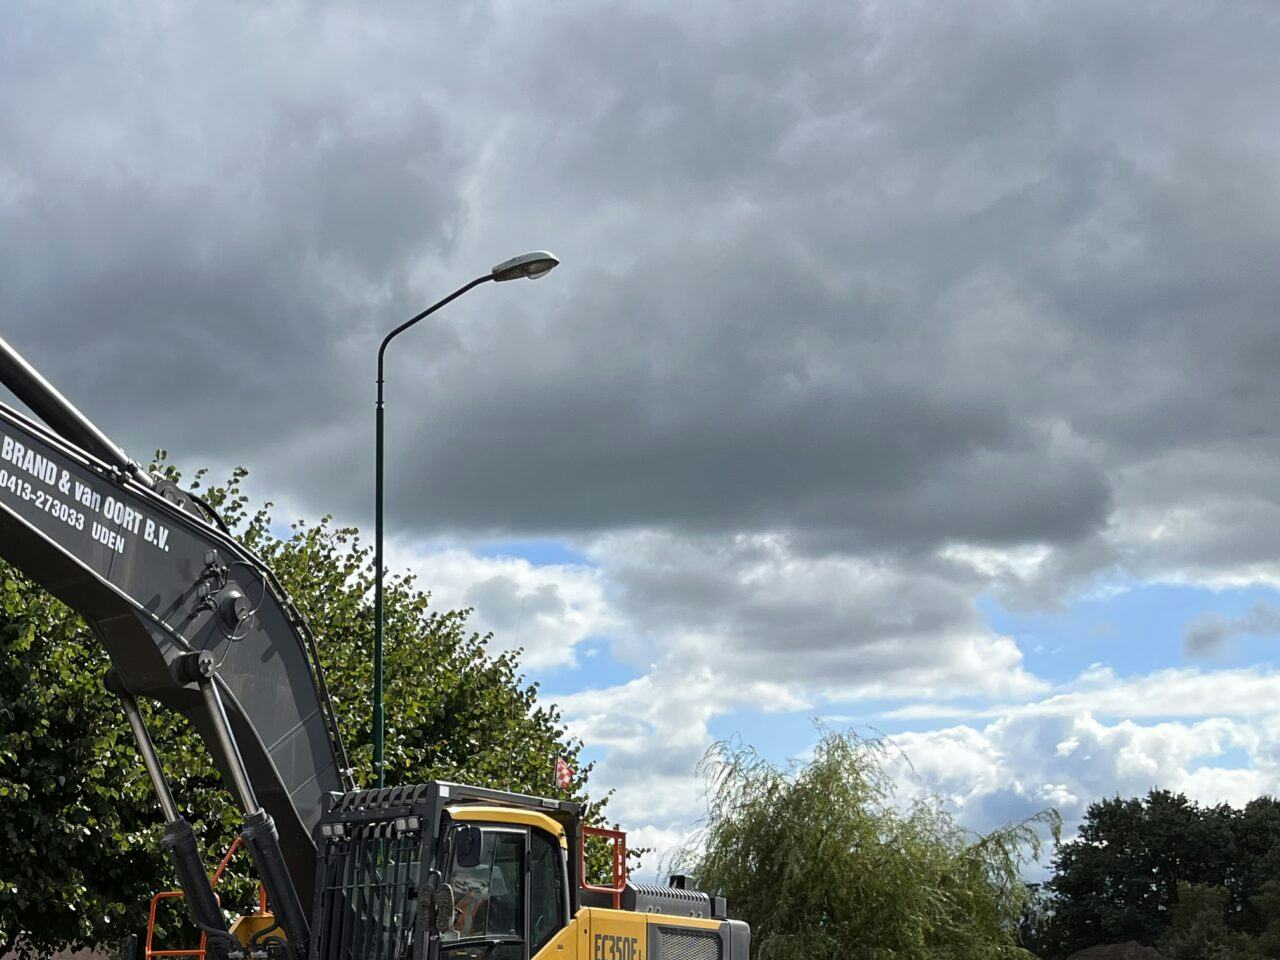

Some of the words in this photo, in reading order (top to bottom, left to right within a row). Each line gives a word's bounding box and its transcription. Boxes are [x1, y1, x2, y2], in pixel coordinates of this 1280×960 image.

[1, 435, 58, 486] BRAND
[58, 470, 71, 496] &
[74, 481, 101, 513] van
[103, 496, 143, 535] OORT
[143, 518, 170, 553] B.V.
[91, 521, 125, 554] UDEN
